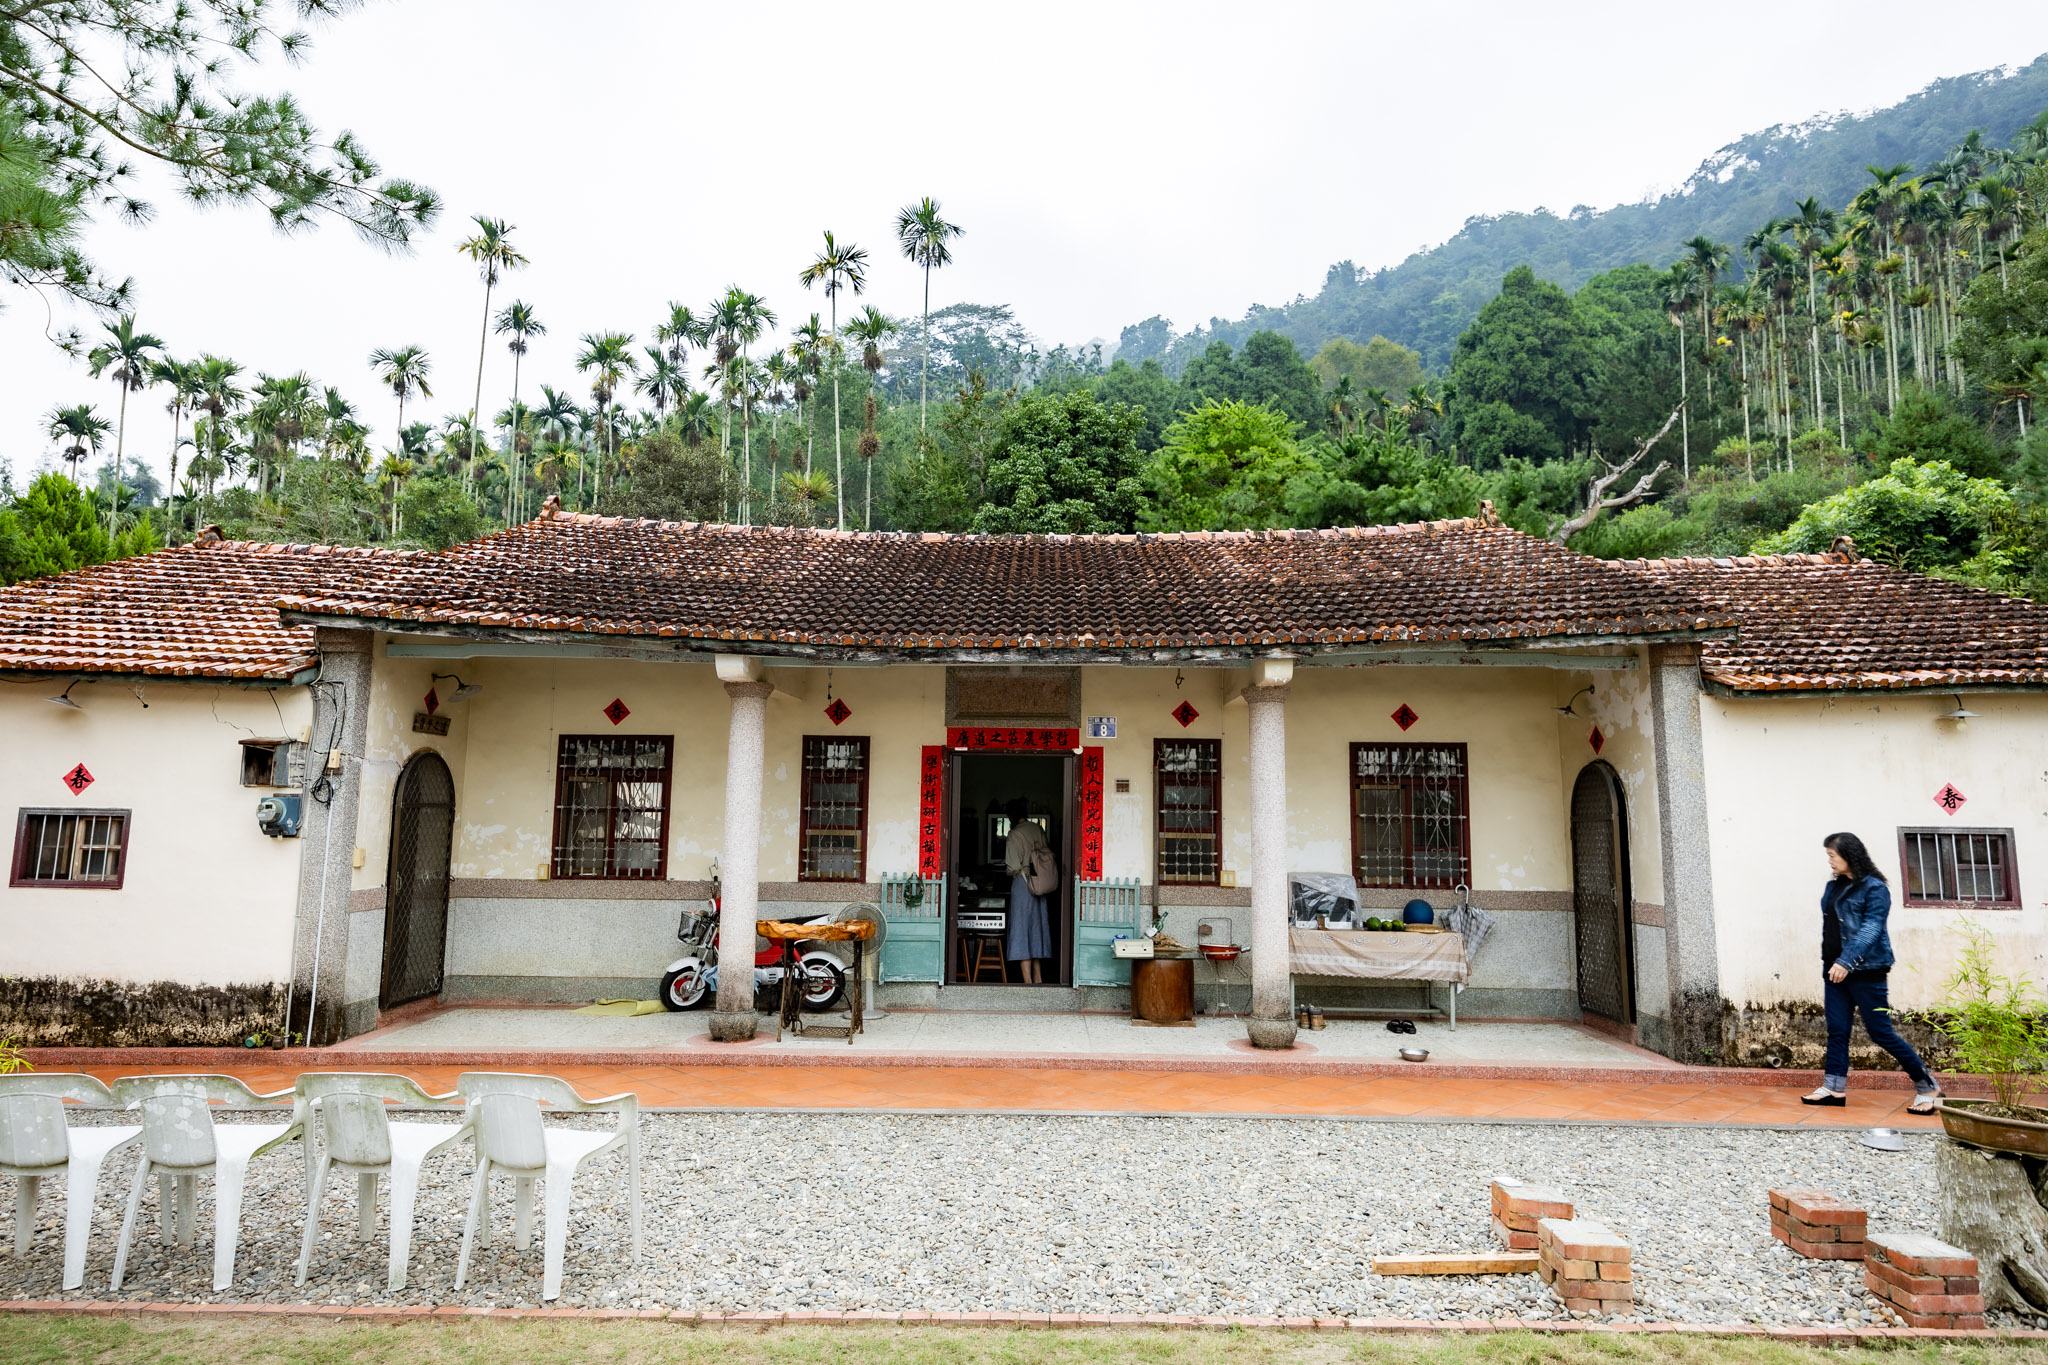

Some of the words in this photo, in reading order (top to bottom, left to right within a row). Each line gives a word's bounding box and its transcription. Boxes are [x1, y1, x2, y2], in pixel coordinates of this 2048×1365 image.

[1100, 724, 1108, 737] 8
[70, 766, 91, 788] 春
[1941, 787, 1964, 808] 春
